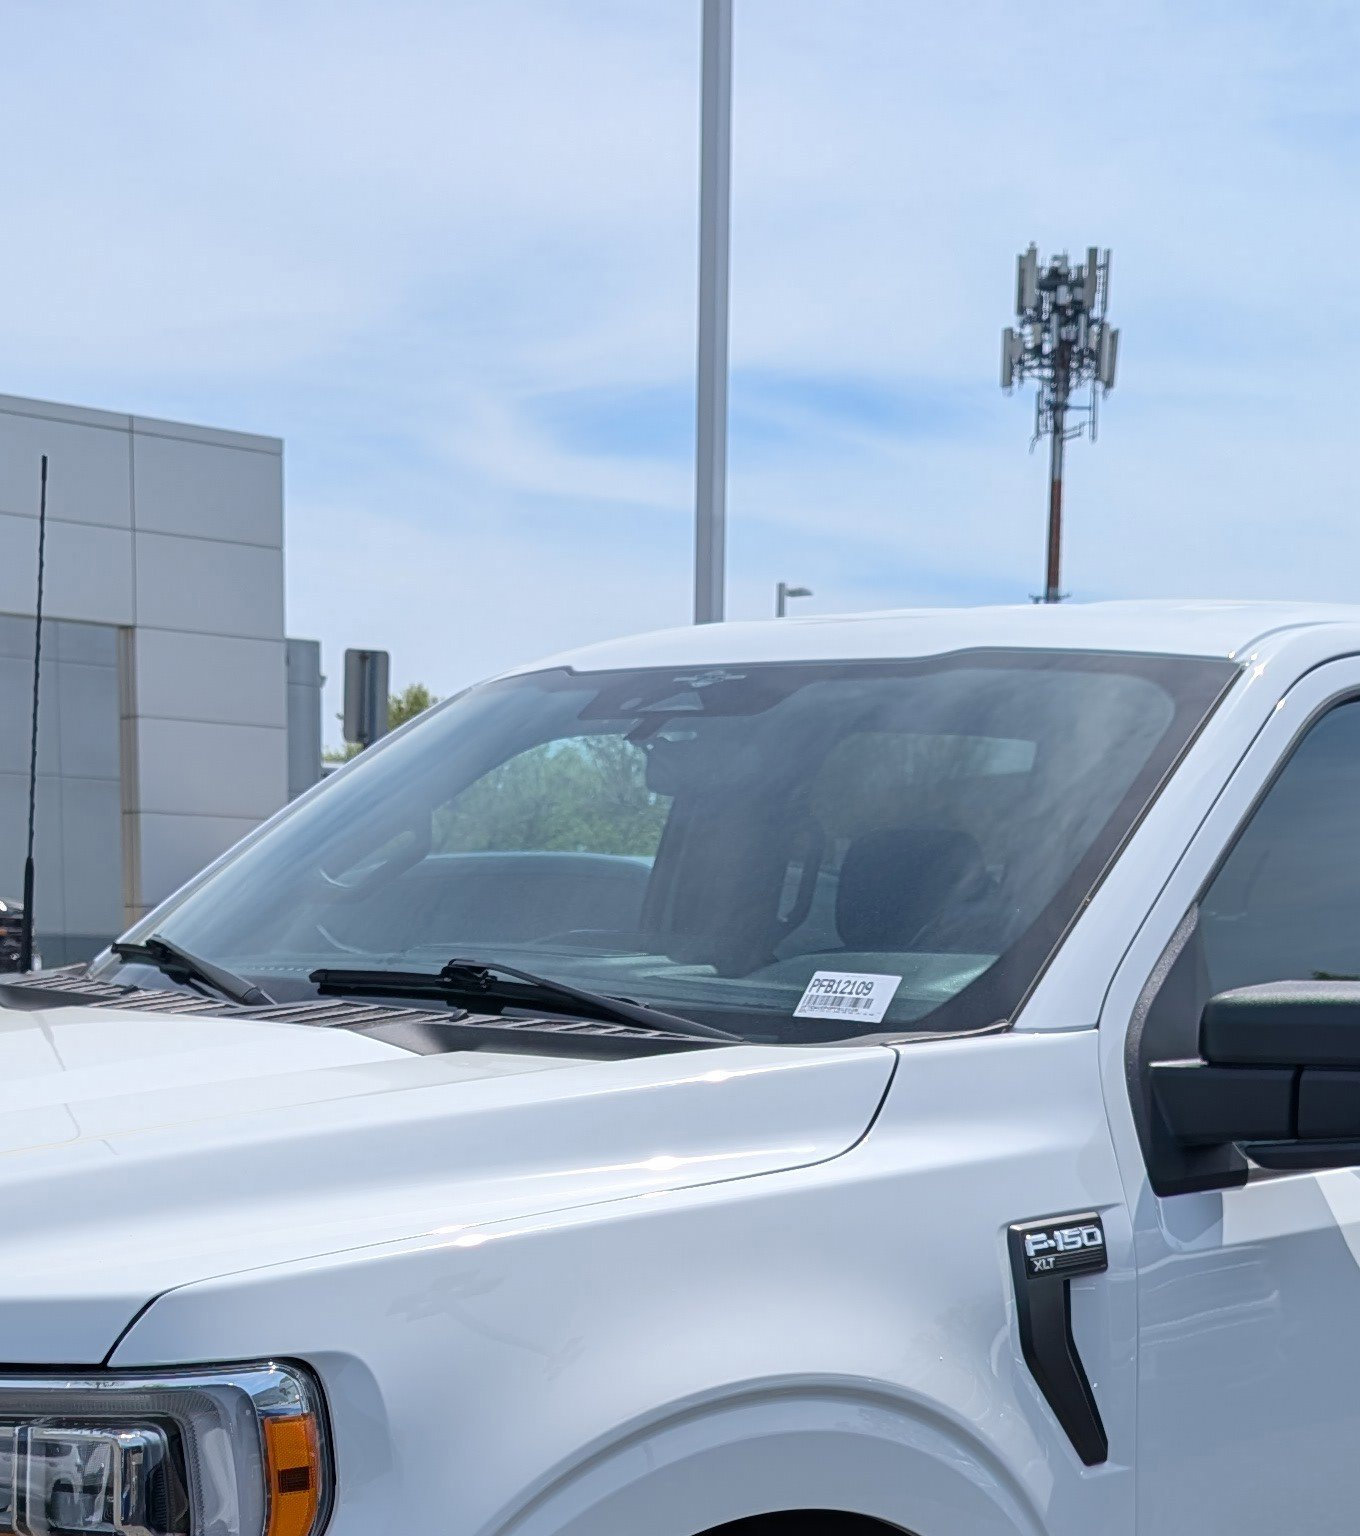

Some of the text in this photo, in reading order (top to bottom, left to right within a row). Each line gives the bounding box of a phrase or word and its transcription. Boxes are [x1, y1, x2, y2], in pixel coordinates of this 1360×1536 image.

[808, 979, 874, 996] PFB12109
[1024, 1225, 1103, 1256] F-150
[1032, 1257, 1055, 1272] XLT
